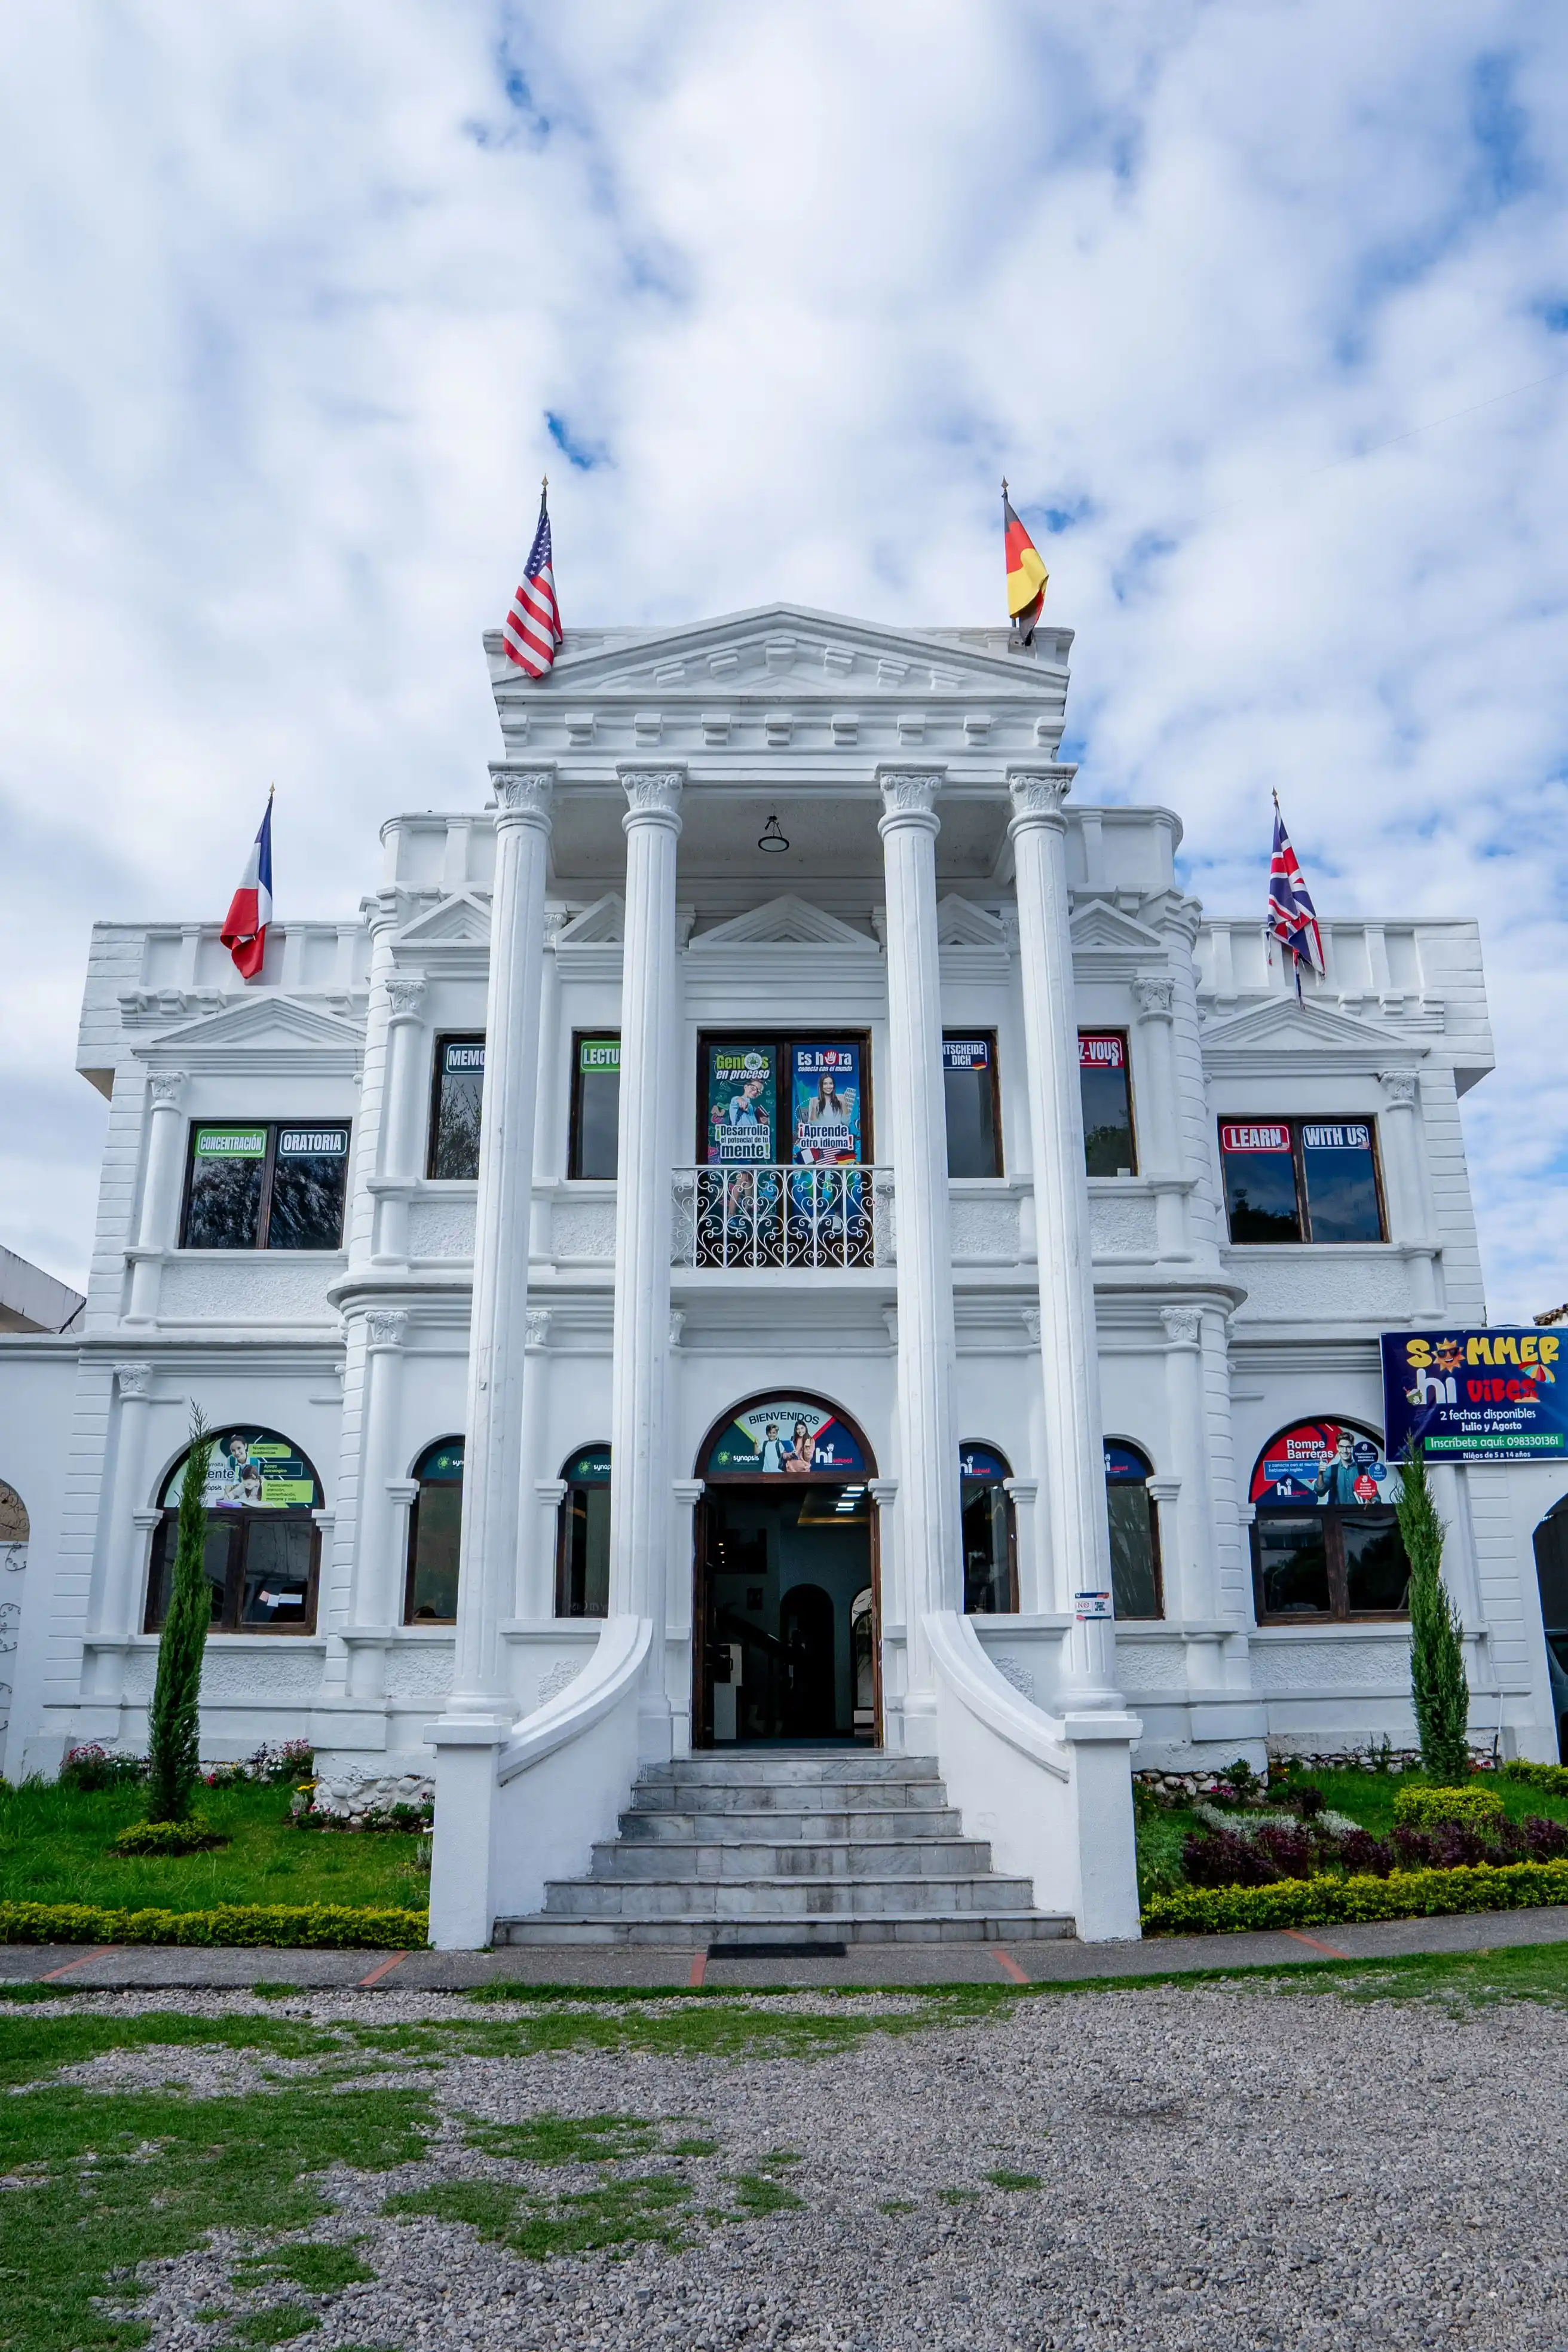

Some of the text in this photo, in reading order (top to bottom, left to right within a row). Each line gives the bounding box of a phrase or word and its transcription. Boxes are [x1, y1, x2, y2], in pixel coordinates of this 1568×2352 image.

[583, 1048, 619, 1064] LECTU
[942, 1044, 984, 1055] NTSCHEIDE
[1078, 1042, 1119, 1060] Z-VOUS
[449, 1050, 485, 1066] MEMO
[798, 1052, 812, 1066] Es
[952, 1055, 972, 1065] DICH
[716, 1070, 770, 1081] en proceso
[800, 1125, 847, 1138] ¡Aprende
[1230, 1128, 1282, 1147] LEARN
[1306, 1127, 1367, 1146] WITH US
[200, 1134, 262, 1151] CONCENTRACIÓN
[283, 1134, 341, 1151] ORATORIA
[801, 1136, 853, 1149] otro idioma!
[721, 1144, 769, 1157] mente!
[1416, 1368, 1457, 1404] hi
[748, 1411, 820, 1425] BIENVENIDOS
[1440, 1408, 1536, 1420] 2 fechas disponibles
[1461, 1422, 1522, 1432] Julio y Agosto
[1287, 1440, 1325, 1450] Rompe
[1431, 1435, 1558, 1448] Inscríbete aquí: 0983301361
[816, 1444, 833, 1463] hi
[1287, 1450, 1334, 1459] Barreras
[1276, 1479, 1291, 1496] hi
